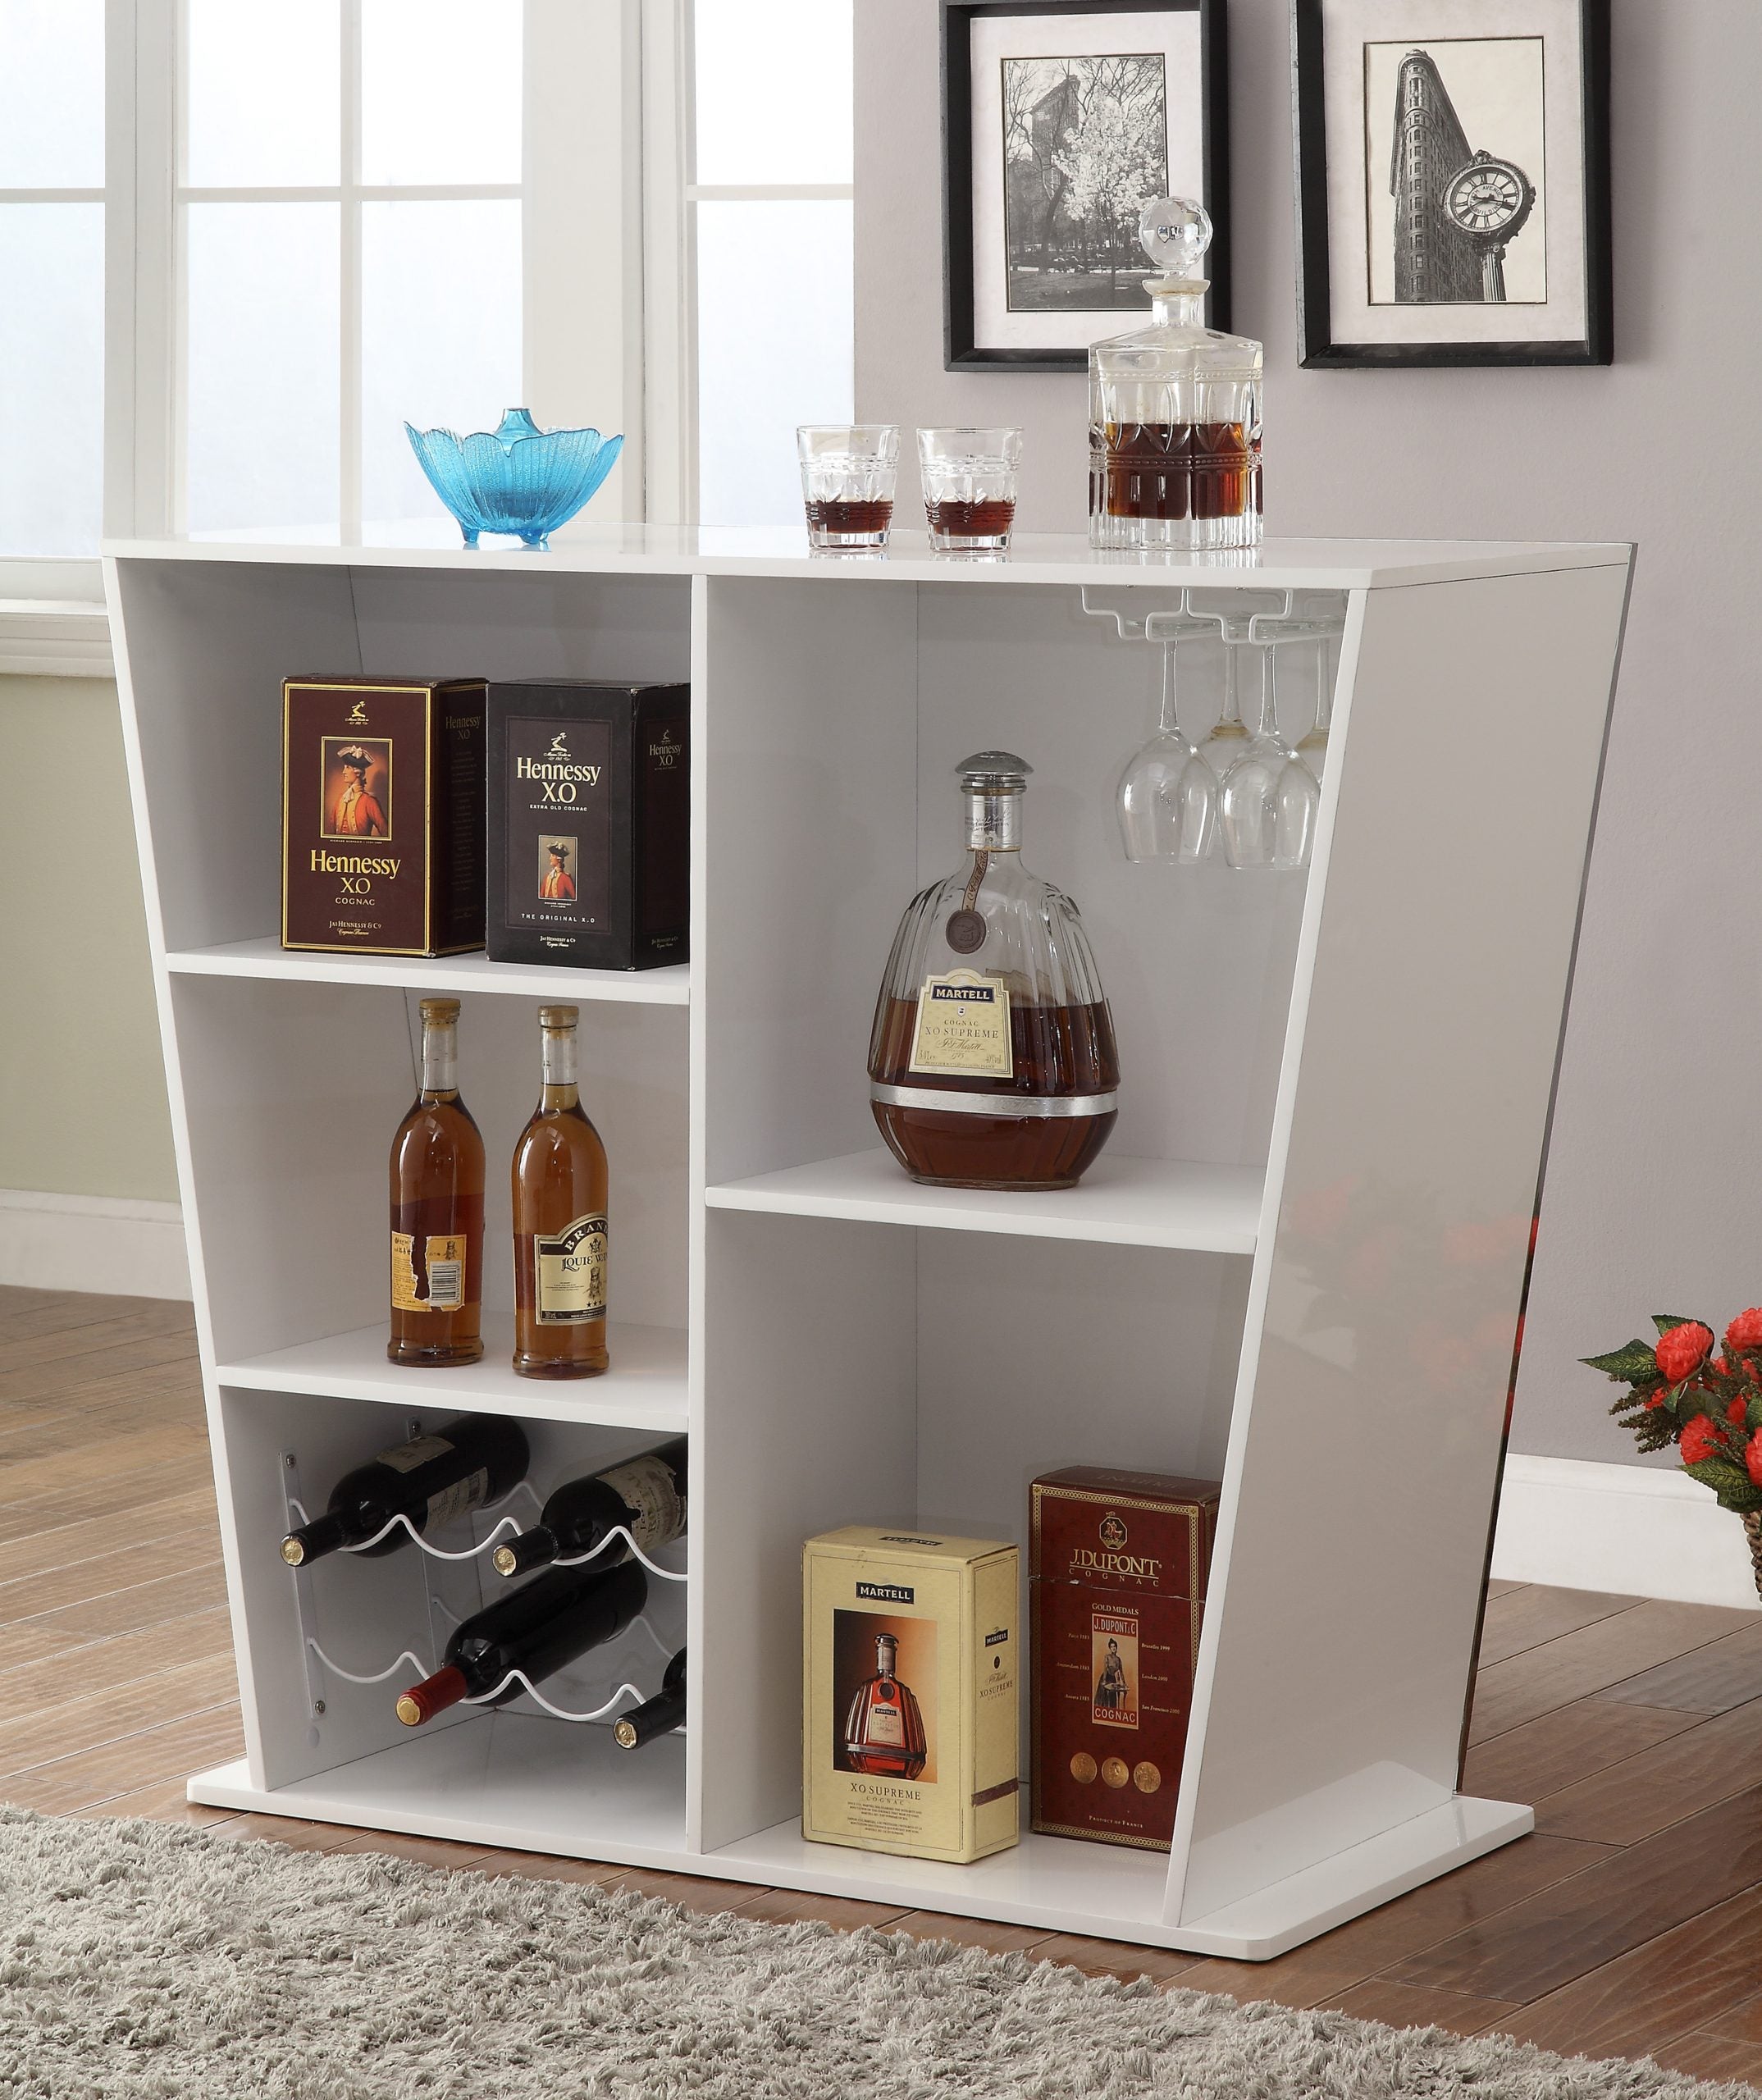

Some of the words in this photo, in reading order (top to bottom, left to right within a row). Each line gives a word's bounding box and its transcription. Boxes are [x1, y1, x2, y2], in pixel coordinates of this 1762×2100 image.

[445, 715, 481, 729] Hennessy
[650, 744, 682, 756] Hennessy
[517, 757, 601, 787] Hennessy
[311, 850, 401, 879] Hennessy
[335, 897, 376, 906] COGNAC
[338, 920, 367, 929] HENNESSY
[540, 914, 577, 922] ORIGINAL
[936, 988, 990, 1000] MARTELL
[944, 1019, 979, 1027] COGNAC
[924, 1026, 941, 1035] XO
[943, 1027, 998, 1039] SUPREME
[1069, 1568, 1159, 1587] COGNAC
[860, 1586, 911, 1600] MARTELL
[1092, 1603, 1112, 1612] GOLD
[1112, 1607, 1139, 1615] MEDALS
[987, 1632, 1007, 1645] MARTELL
[988, 1680, 1013, 1696] SUPREME
[1094, 1708, 1136, 1723] COGNAC
[851, 1783, 866, 1793] XO
[869, 1785, 921, 1801] SUPREME
[866, 1796, 905, 1806] COGNAC
[1089, 1815, 1113, 1824] PRODUCT
[1122, 1819, 1143, 1828] FRANCE
